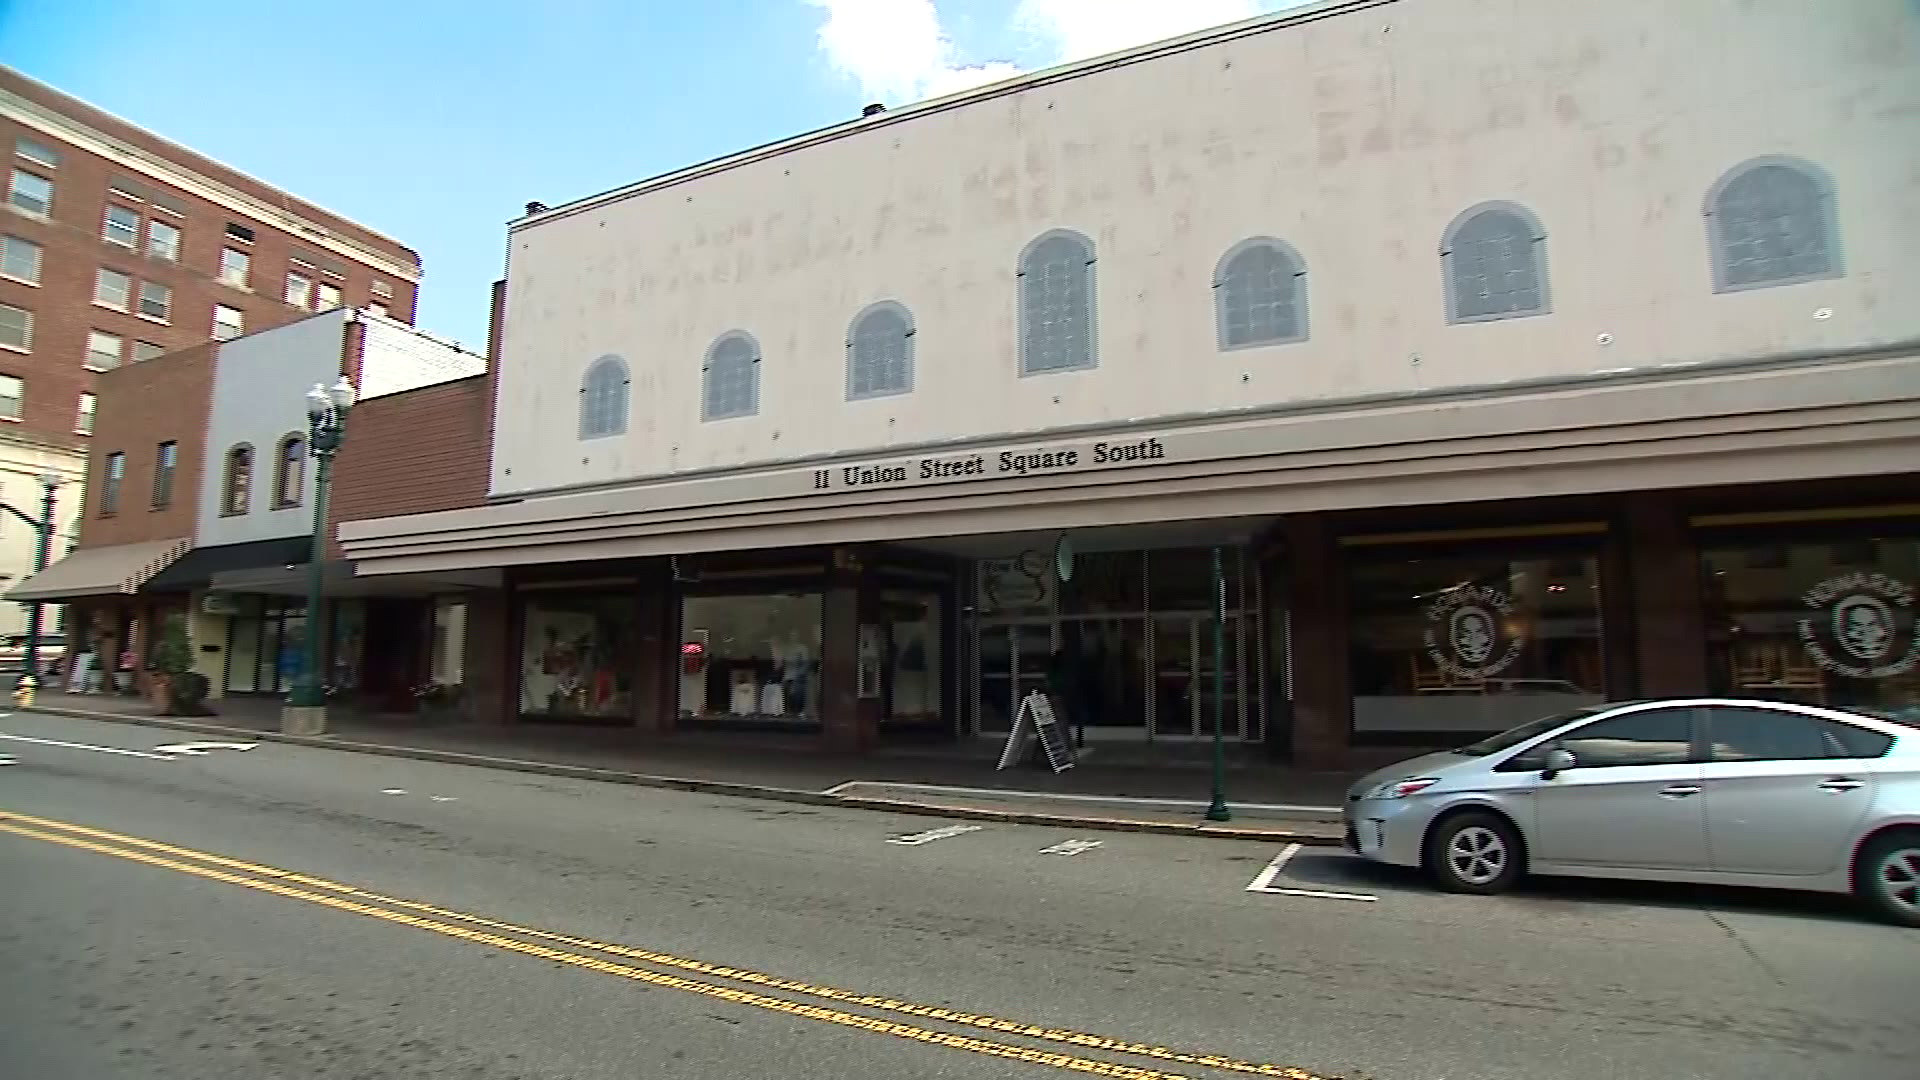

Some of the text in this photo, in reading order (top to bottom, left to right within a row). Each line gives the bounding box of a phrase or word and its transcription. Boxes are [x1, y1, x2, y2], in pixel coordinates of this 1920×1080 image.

[843, 466, 908, 485] Union
[920, 456, 985, 478] Street
[999, 451, 1079, 474] Square
[1094, 437, 1165, 463] South
